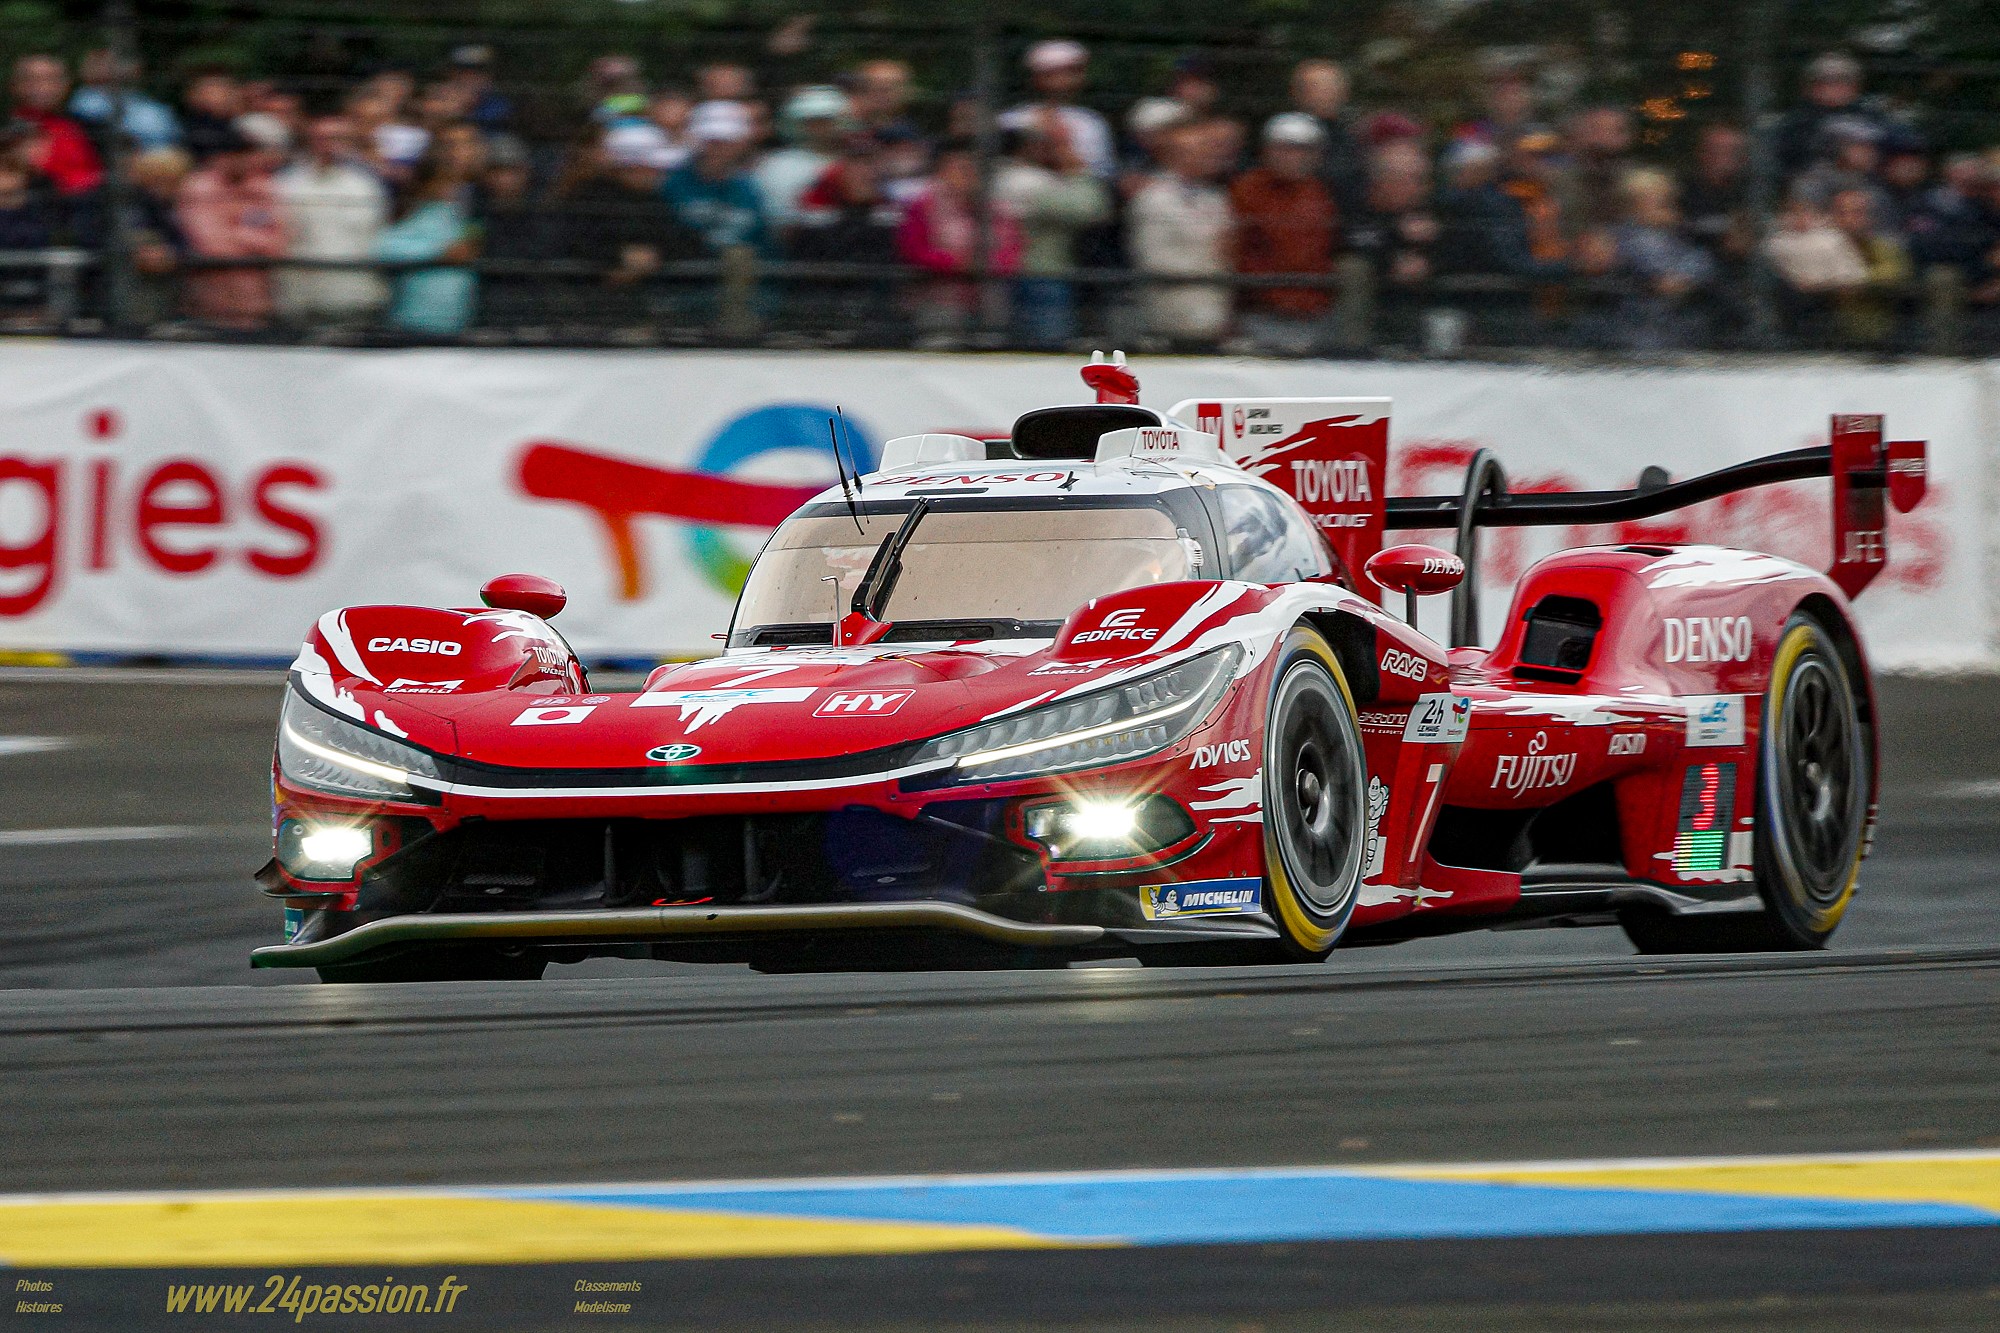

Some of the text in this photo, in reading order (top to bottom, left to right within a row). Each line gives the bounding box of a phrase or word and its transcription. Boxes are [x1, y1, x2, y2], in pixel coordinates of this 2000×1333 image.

[1141, 430, 1180, 450] TOYOTA
[873, 472, 1065, 486] DENSO
[1291, 460, 1372, 503] TOYOTA
[1839, 530, 1883, 563] JFE
[1422, 558, 1464, 575] DENSO
[367, 637, 462, 656] CASIO
[1071, 628, 1159, 645] EDIFICE
[1663, 615, 1752, 663] DENSO
[1381, 649, 1427, 682] RAYS
[822, 692, 908, 713] HY
[1490, 752, 1578, 799] FUJITSU
[1182, 888, 1255, 907] MICHELIN
